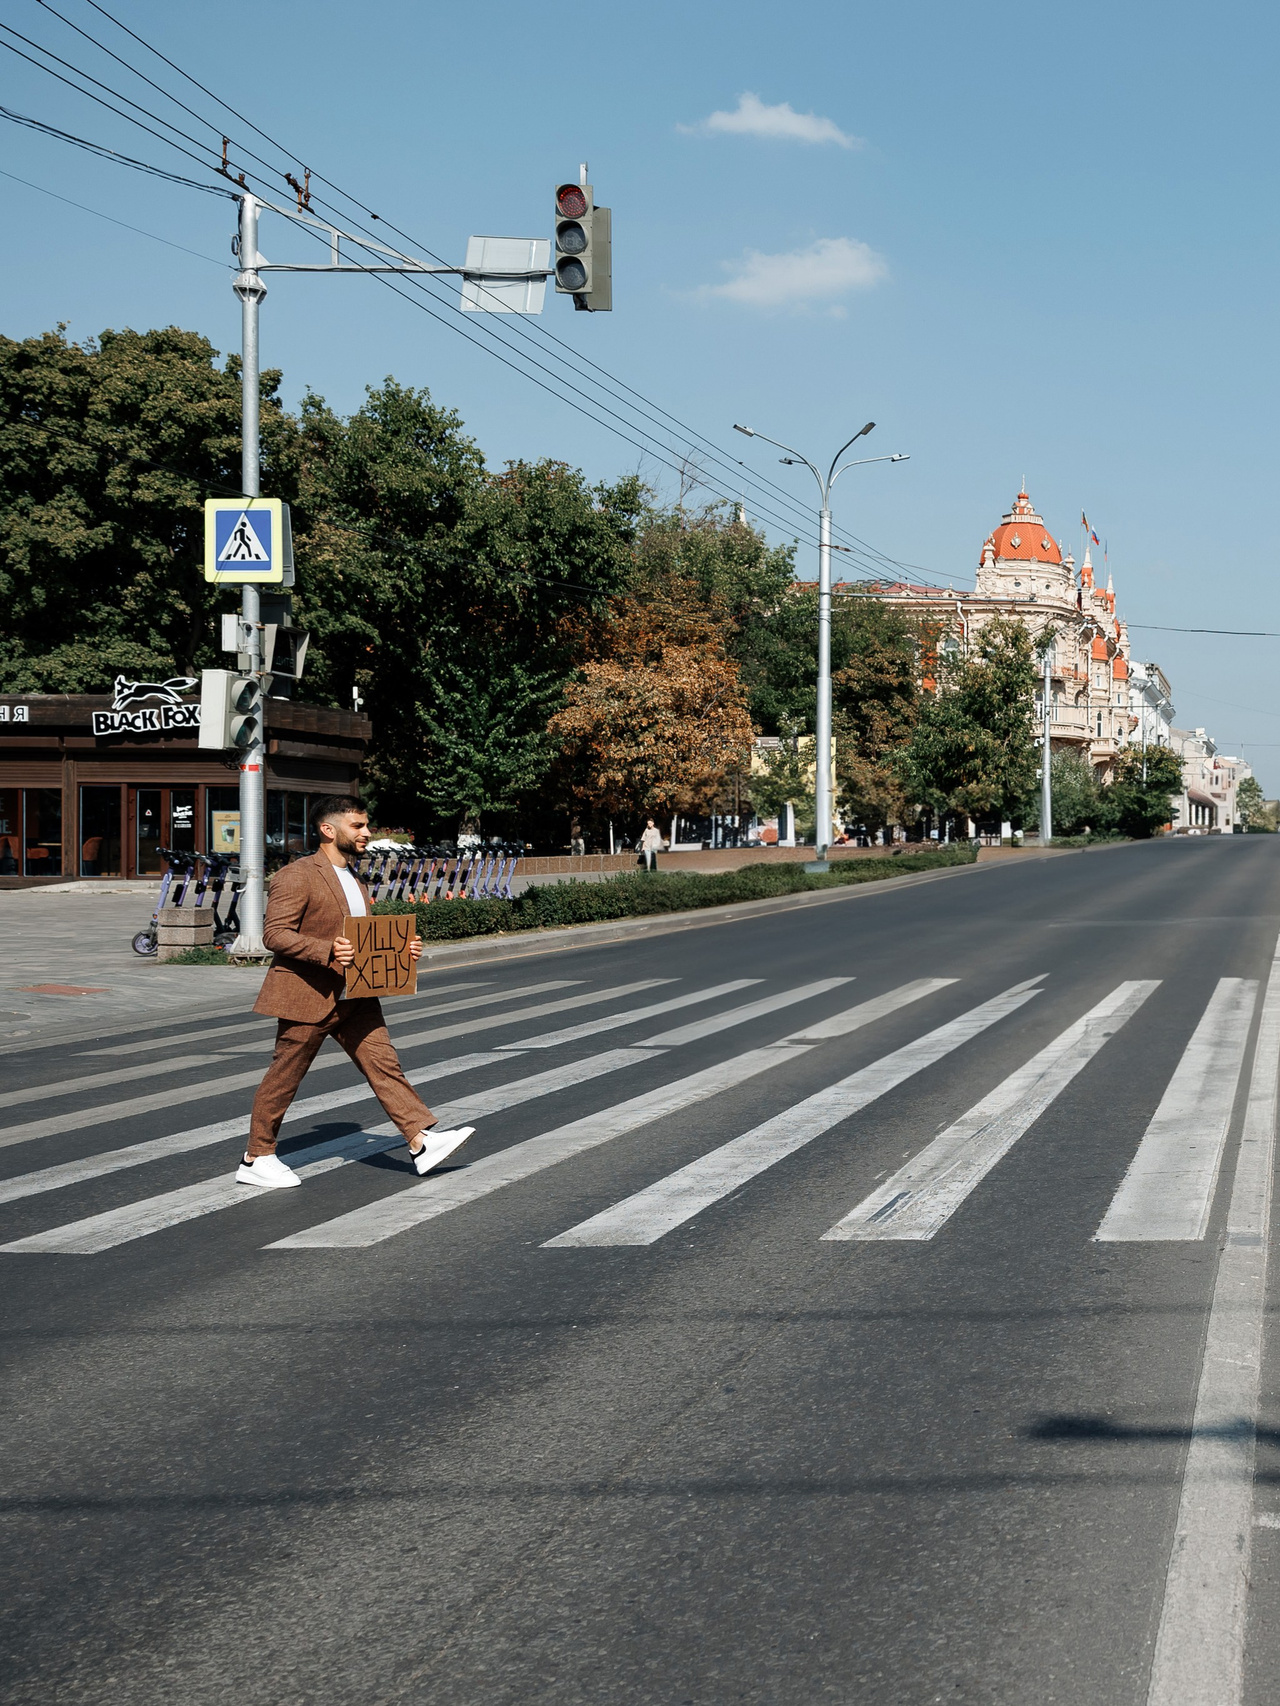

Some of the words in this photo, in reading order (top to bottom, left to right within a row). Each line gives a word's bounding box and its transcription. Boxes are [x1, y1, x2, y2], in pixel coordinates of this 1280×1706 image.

[93, 709, 160, 735] BLACK
[161, 704, 202, 729] FOX
[357, 920, 410, 954] ИЩУ
[349, 953, 411, 993] ЖЕНУ
